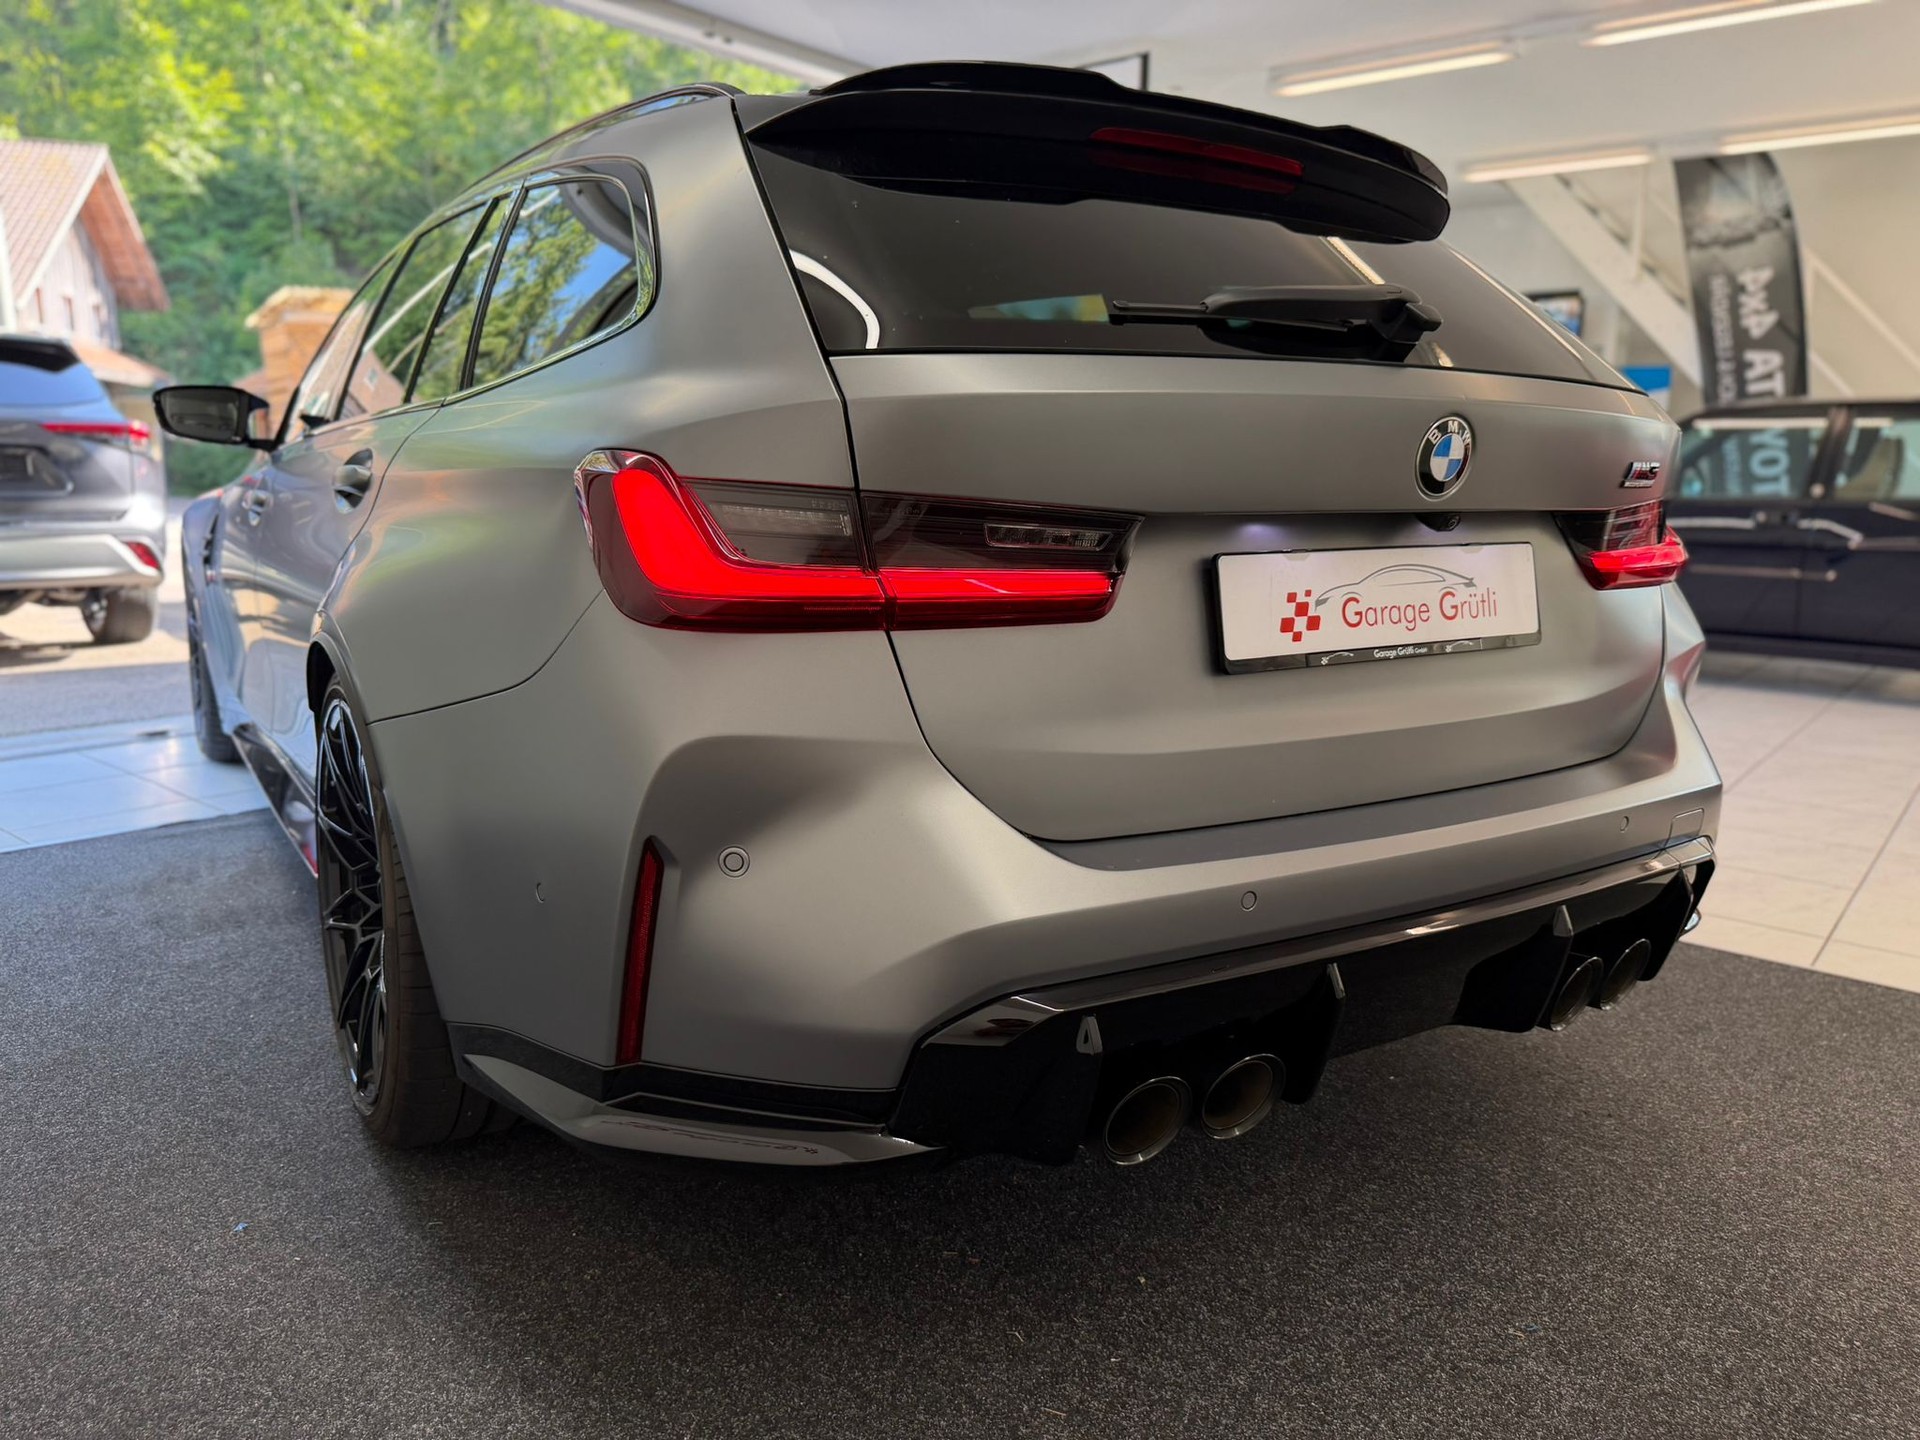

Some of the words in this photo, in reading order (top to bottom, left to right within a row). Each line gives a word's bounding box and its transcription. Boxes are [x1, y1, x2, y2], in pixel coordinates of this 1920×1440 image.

[1427, 420, 1471, 449] BMW
[1341, 596, 1431, 631] Garage
[1438, 587, 1498, 621] Grütli
[1373, 649, 1397, 659] Garage
[1397, 646, 1414, 655] Grütli
